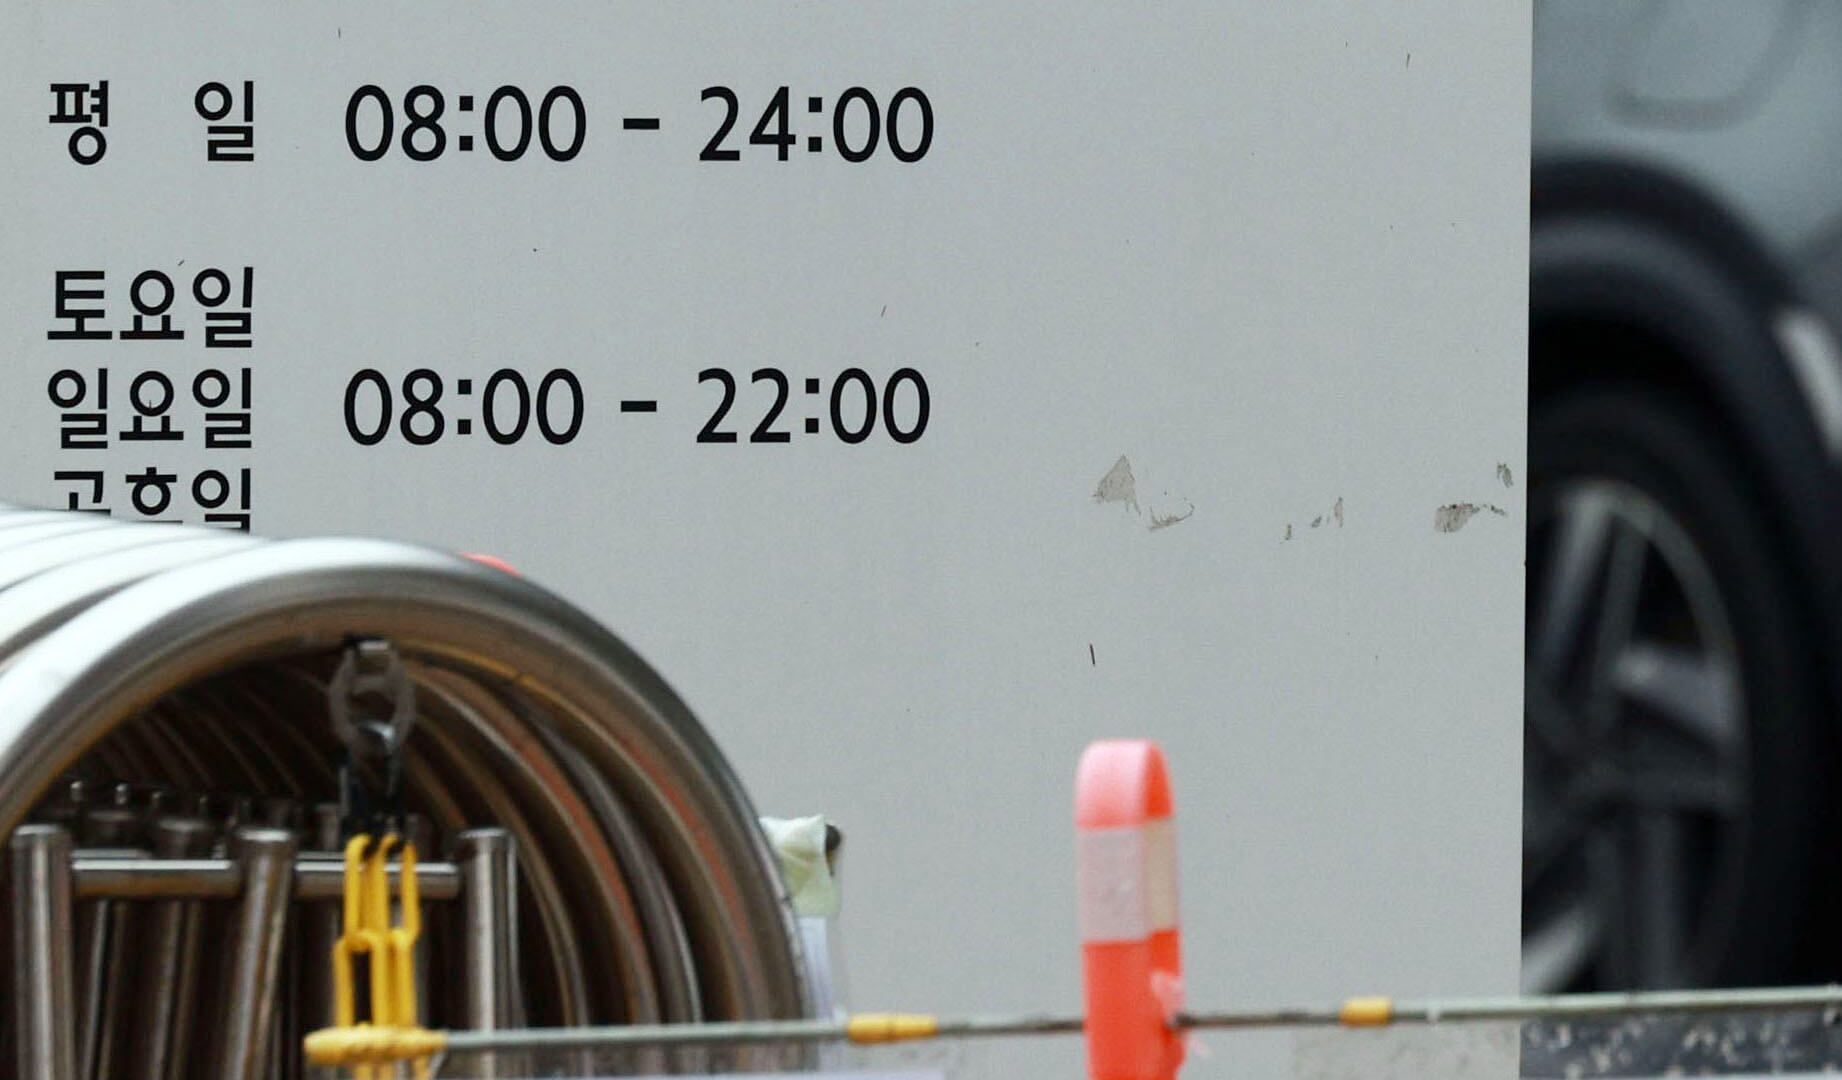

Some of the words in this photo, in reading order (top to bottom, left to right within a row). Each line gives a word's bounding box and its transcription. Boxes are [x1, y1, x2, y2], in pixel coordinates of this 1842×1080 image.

[345, 84, 587, 163] 08:00
[699, 85, 934, 163] 24:00
[47, 266, 254, 349] 토요일
[47, 367, 252, 450] 일요일
[343, 368, 585, 447] 08:00
[696, 367, 931, 445] 22:00
